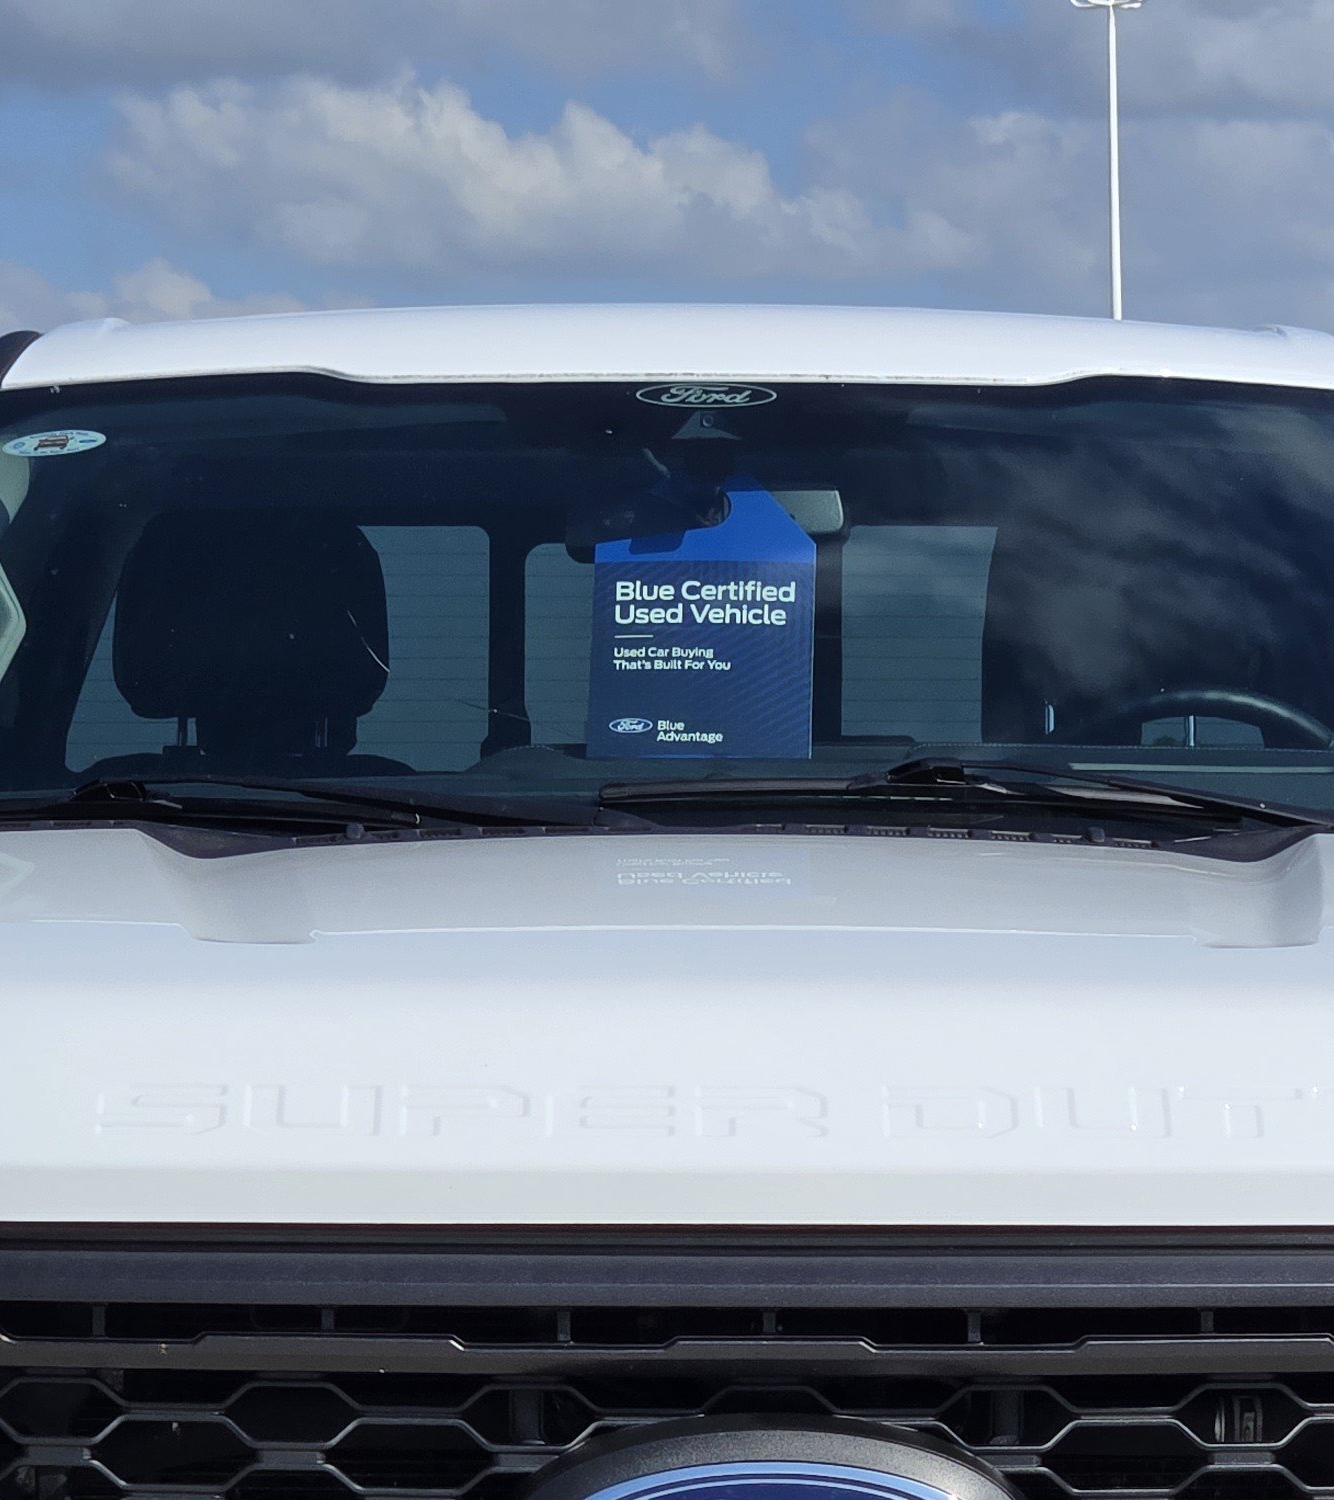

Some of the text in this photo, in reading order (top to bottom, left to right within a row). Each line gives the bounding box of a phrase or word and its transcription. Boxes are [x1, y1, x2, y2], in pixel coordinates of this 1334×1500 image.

[660, 385, 751, 405] Ford
[616, 581, 795, 602] Blue Certified
[615, 603, 786, 625] Used Vehicle
[614, 647, 713, 658] Used Car Buying
[613, 660, 731, 670] That's Built For You
[617, 720, 646, 732] Ford
[658, 720, 684, 730] Blue
[657, 731, 723, 743] Advantage
[95, 1084, 829, 1138] SUPER
